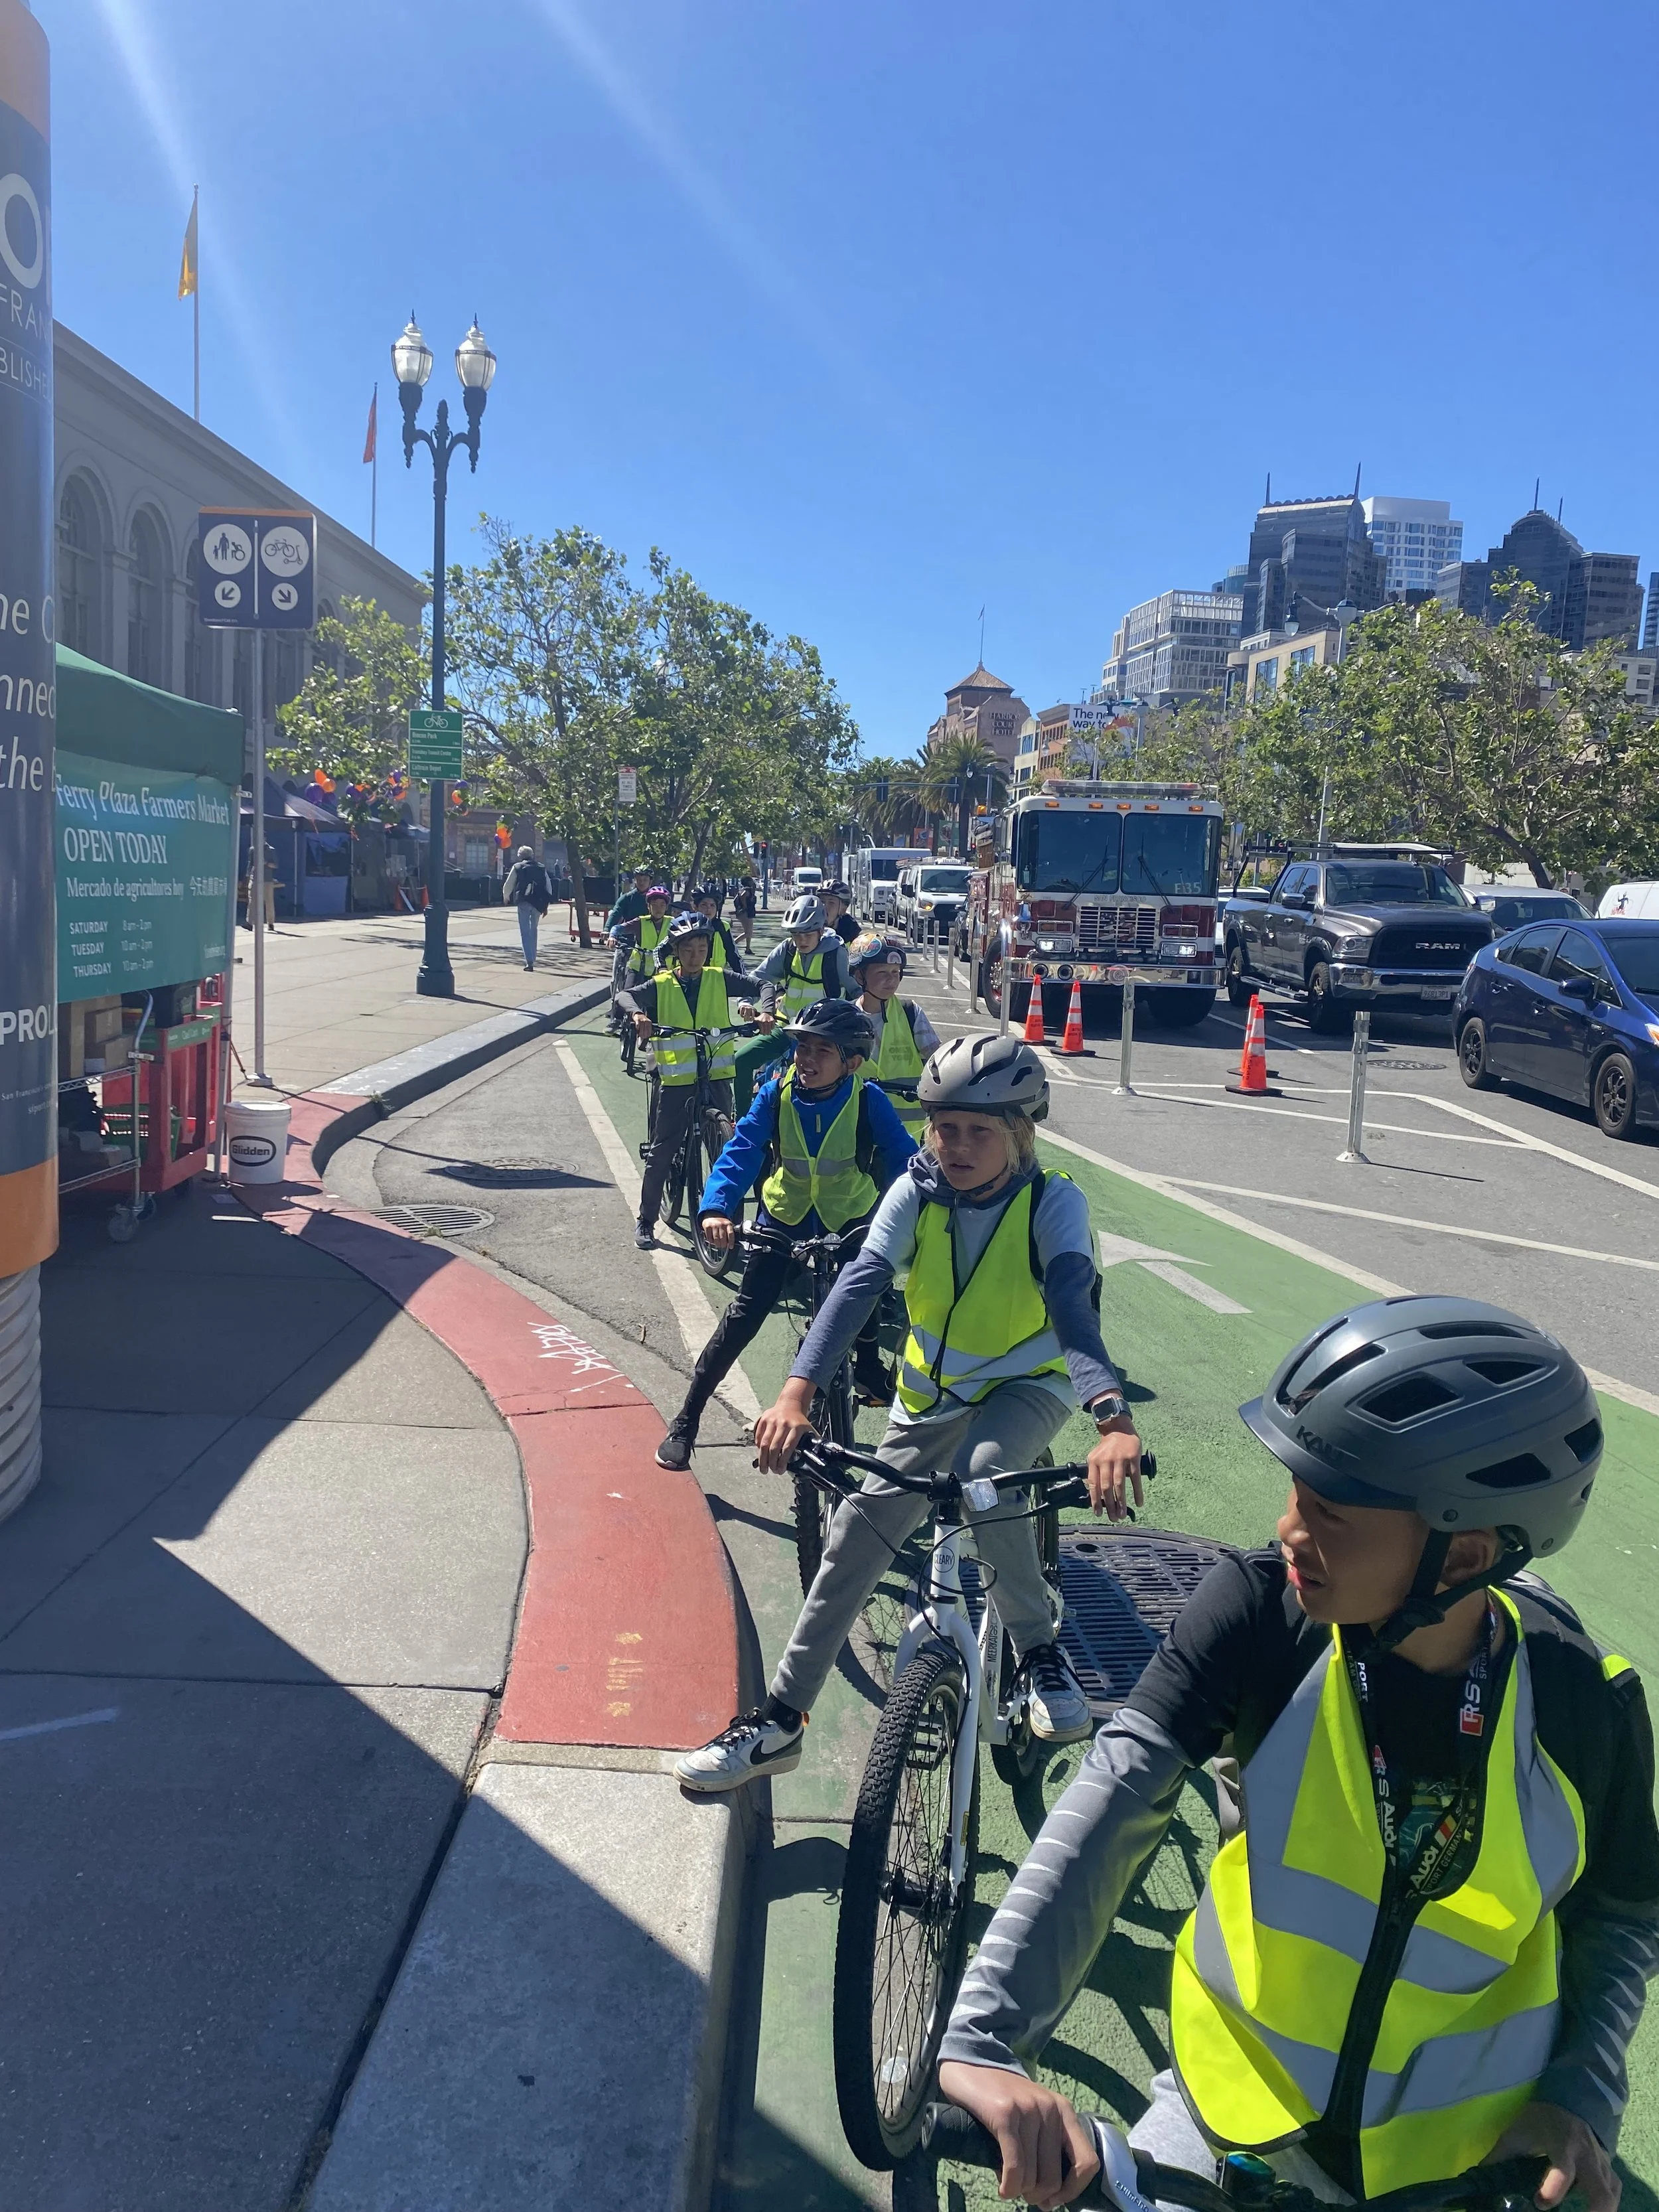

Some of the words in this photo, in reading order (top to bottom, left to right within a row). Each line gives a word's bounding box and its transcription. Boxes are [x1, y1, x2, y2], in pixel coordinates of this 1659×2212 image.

[989, 712, 1021, 721] HARBOR
[1073, 707, 1094, 719] The
[1072, 720, 1095, 729] way
[56, 774, 98, 821] Ferry
[100, 781, 140, 816] Plaza
[141, 787, 196, 821] Farmers
[197, 794, 230, 826] Market
[64, 827, 115, 862] OPEN
[115, 832, 167, 864] TODAY
[66, 877, 111, 897] Mercado
[113, 877, 124, 897] de
[126, 879, 171, 902] agricultores
[69, 921, 109, 934] SATURDAY
[71, 942, 105, 956] TUESDAY
[73, 962, 112, 978] THURSDAY
[232, 1144, 270, 1157] Glidden
[934, 1554, 954, 1566] CLEARY
[987, 1634, 998, 1663] MEERKAT
[1409, 1845, 1440, 1889] Audi
